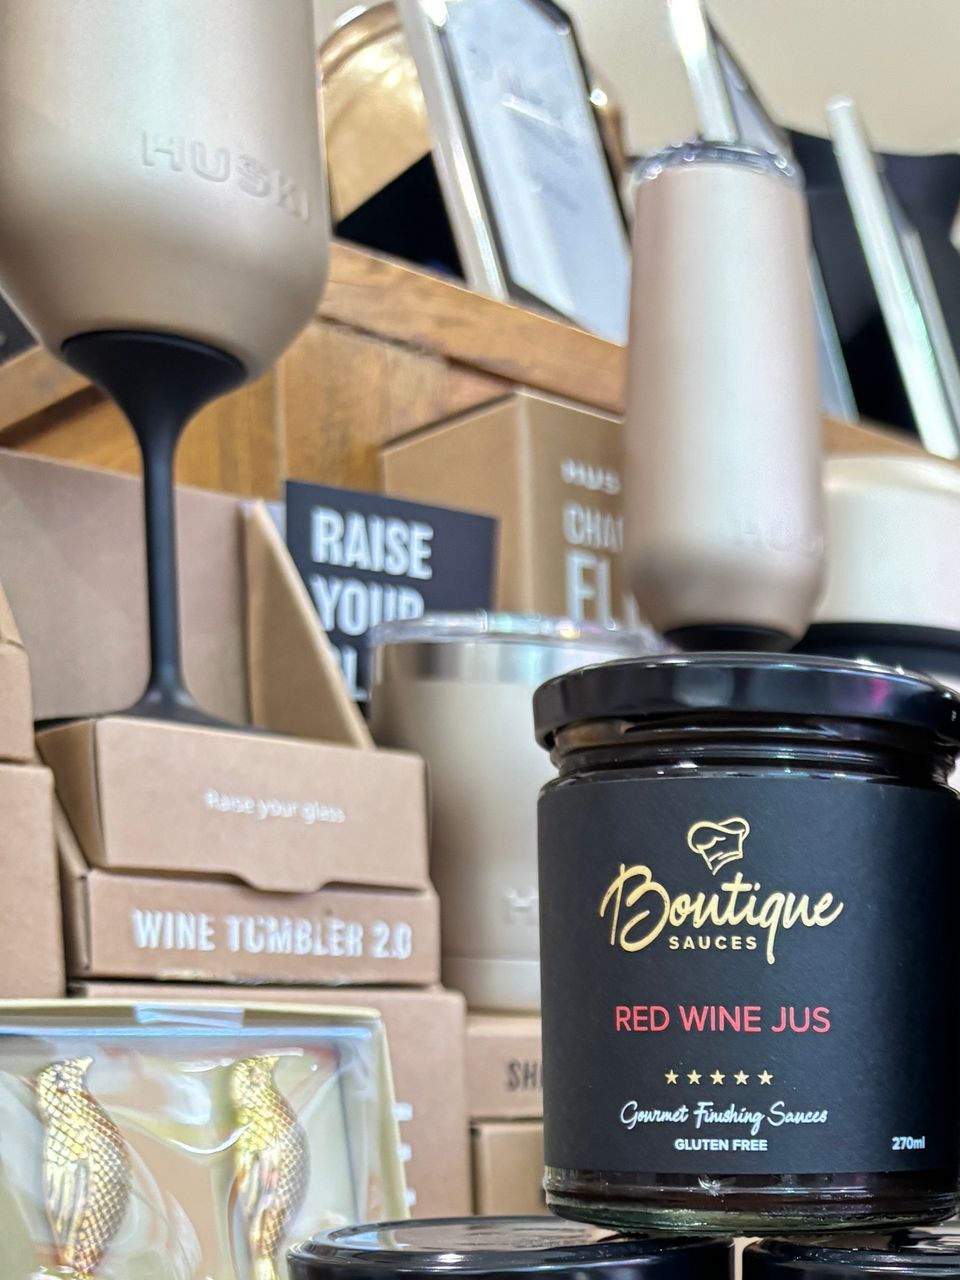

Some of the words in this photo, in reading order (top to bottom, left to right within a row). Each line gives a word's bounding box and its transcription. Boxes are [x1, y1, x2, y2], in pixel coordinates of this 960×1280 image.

[141, 130, 310, 224] HUSKI
[311, 506, 434, 580] RAISE
[256, 799, 297, 821] your
[301, 801, 346, 825] glass
[600, 863, 844, 964] Boutique
[132, 909, 216, 951] WINE
[225, 914, 364, 958] TUMBLER
[371, 920, 412, 960] 2.0
[669, 936, 756, 949] SAUCES
[616, 1006, 669, 1031] RED
[679, 1006, 761, 1032] WINE
[772, 1007, 830, 1032] JUS
[506, 1059, 544, 1090] SH
[620, 1101, 688, 1129] Gourmet
[694, 1102, 765, 1136] Finishing
[767, 1101, 828, 1126] Sauces
[675, 1139, 729, 1150] GLUTEN
[733, 1139, 767, 1151] FREE
[892, 1136, 925, 1150] 270ml
